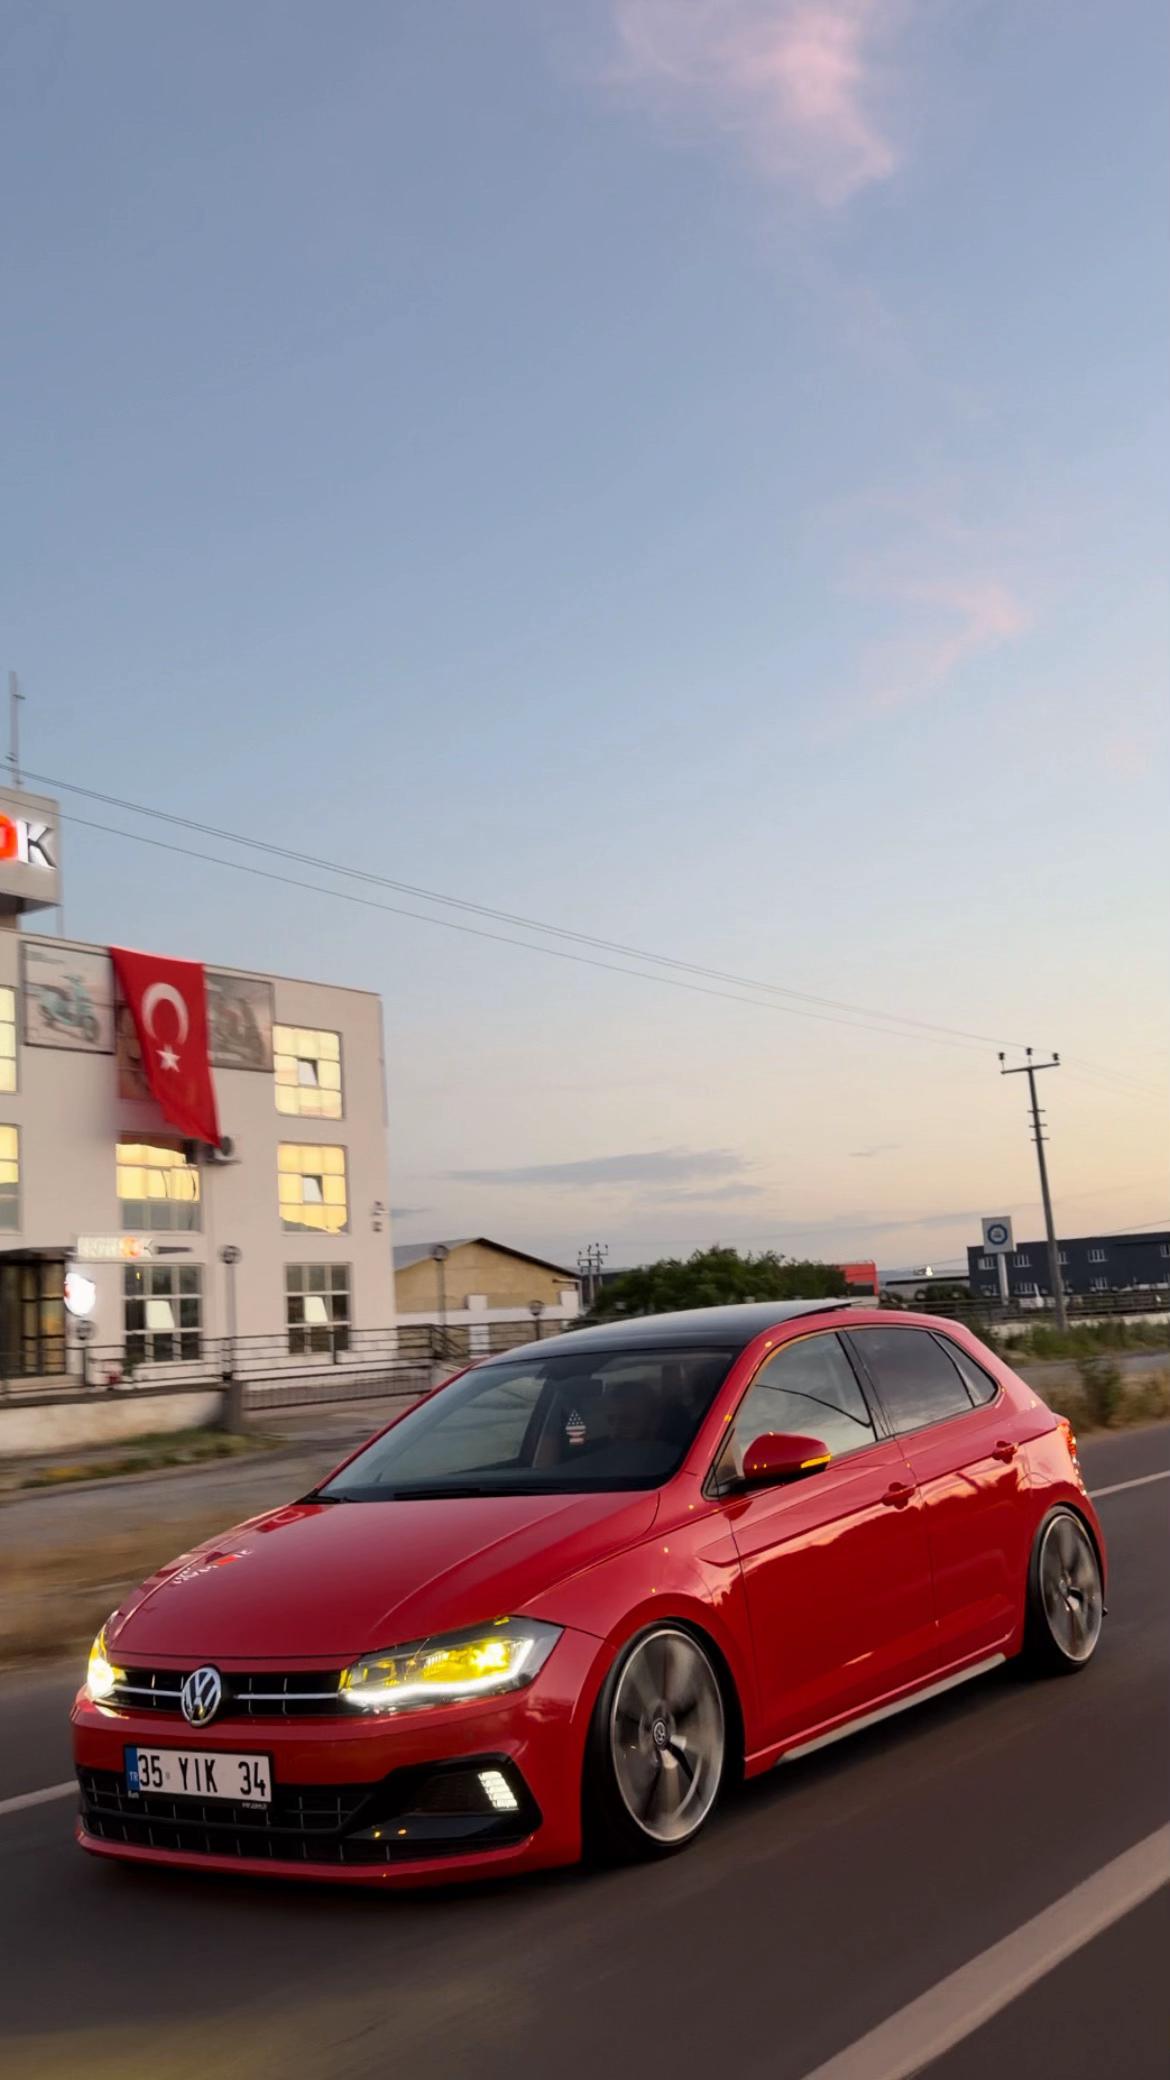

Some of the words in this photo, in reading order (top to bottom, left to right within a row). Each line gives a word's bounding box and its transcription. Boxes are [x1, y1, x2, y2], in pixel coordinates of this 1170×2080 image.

[129, 1770, 139, 1782] TR
[138, 1754, 163, 1788] 35
[178, 1757, 218, 1793] YIK
[238, 1761, 266, 1797] 34
